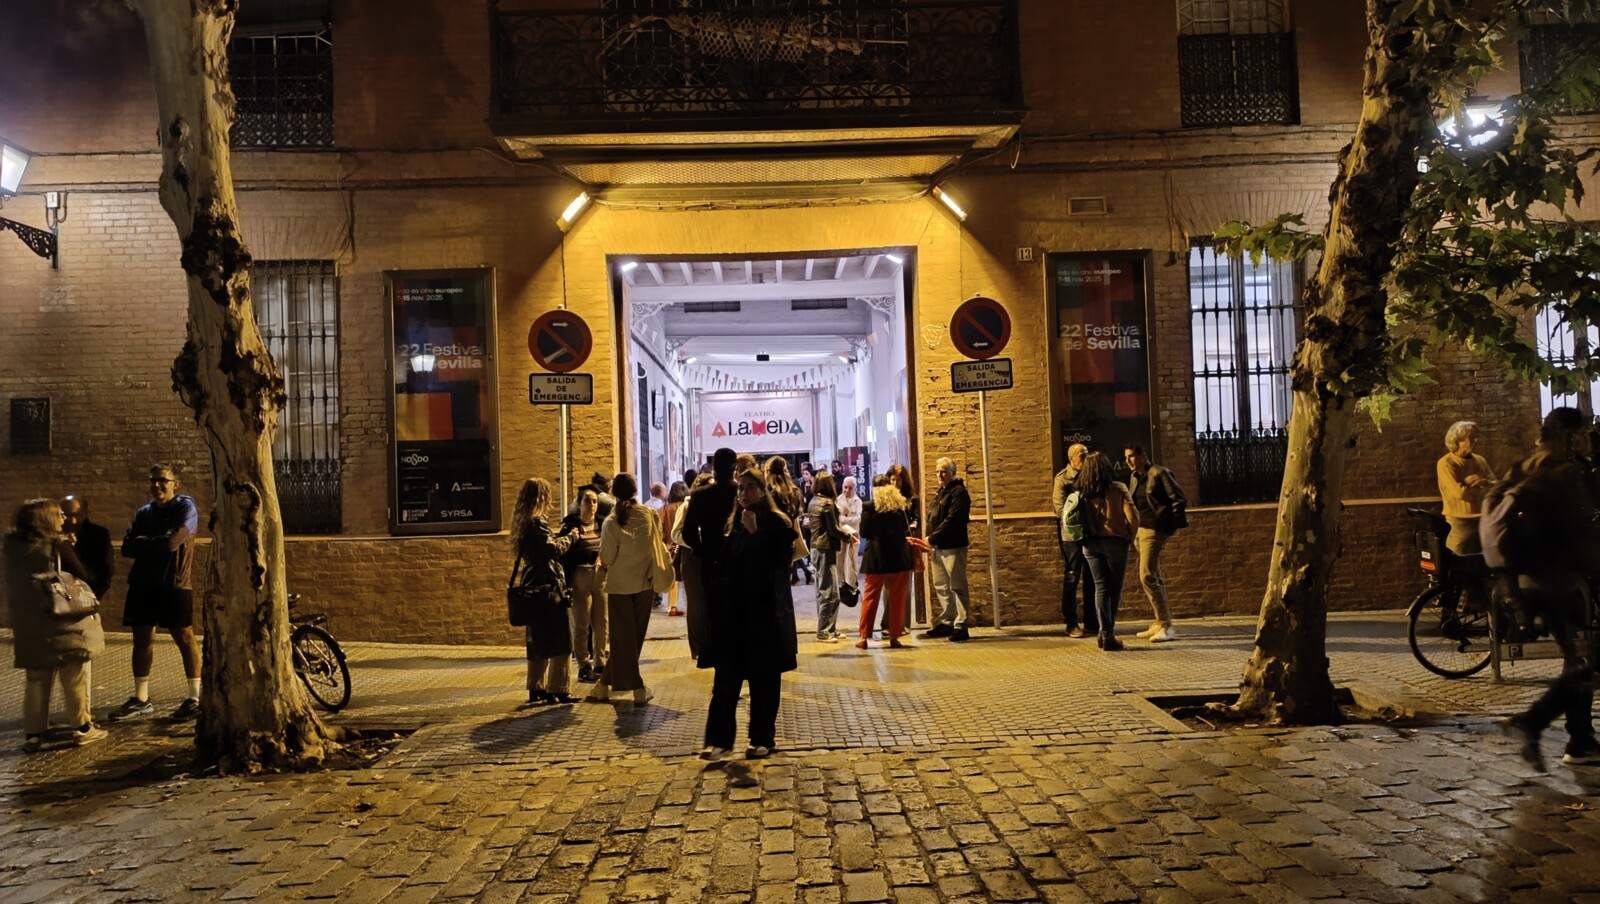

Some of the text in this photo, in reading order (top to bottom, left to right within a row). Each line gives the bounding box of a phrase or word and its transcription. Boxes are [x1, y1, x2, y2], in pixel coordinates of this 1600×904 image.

[1020, 248, 1031, 260] 13
[435, 287, 463, 295] europeo
[1061, 324, 1081, 337] 22
[1087, 336, 1141, 350] Sevilla
[400, 343, 420, 356] 22
[434, 356, 482, 369] evilla
[966, 363, 996, 372] SALIDA
[955, 378, 1009, 389] EMERGENCIA
[856, 453, 866, 484] Sevilla
[440, 509, 474, 518] SYRSA
